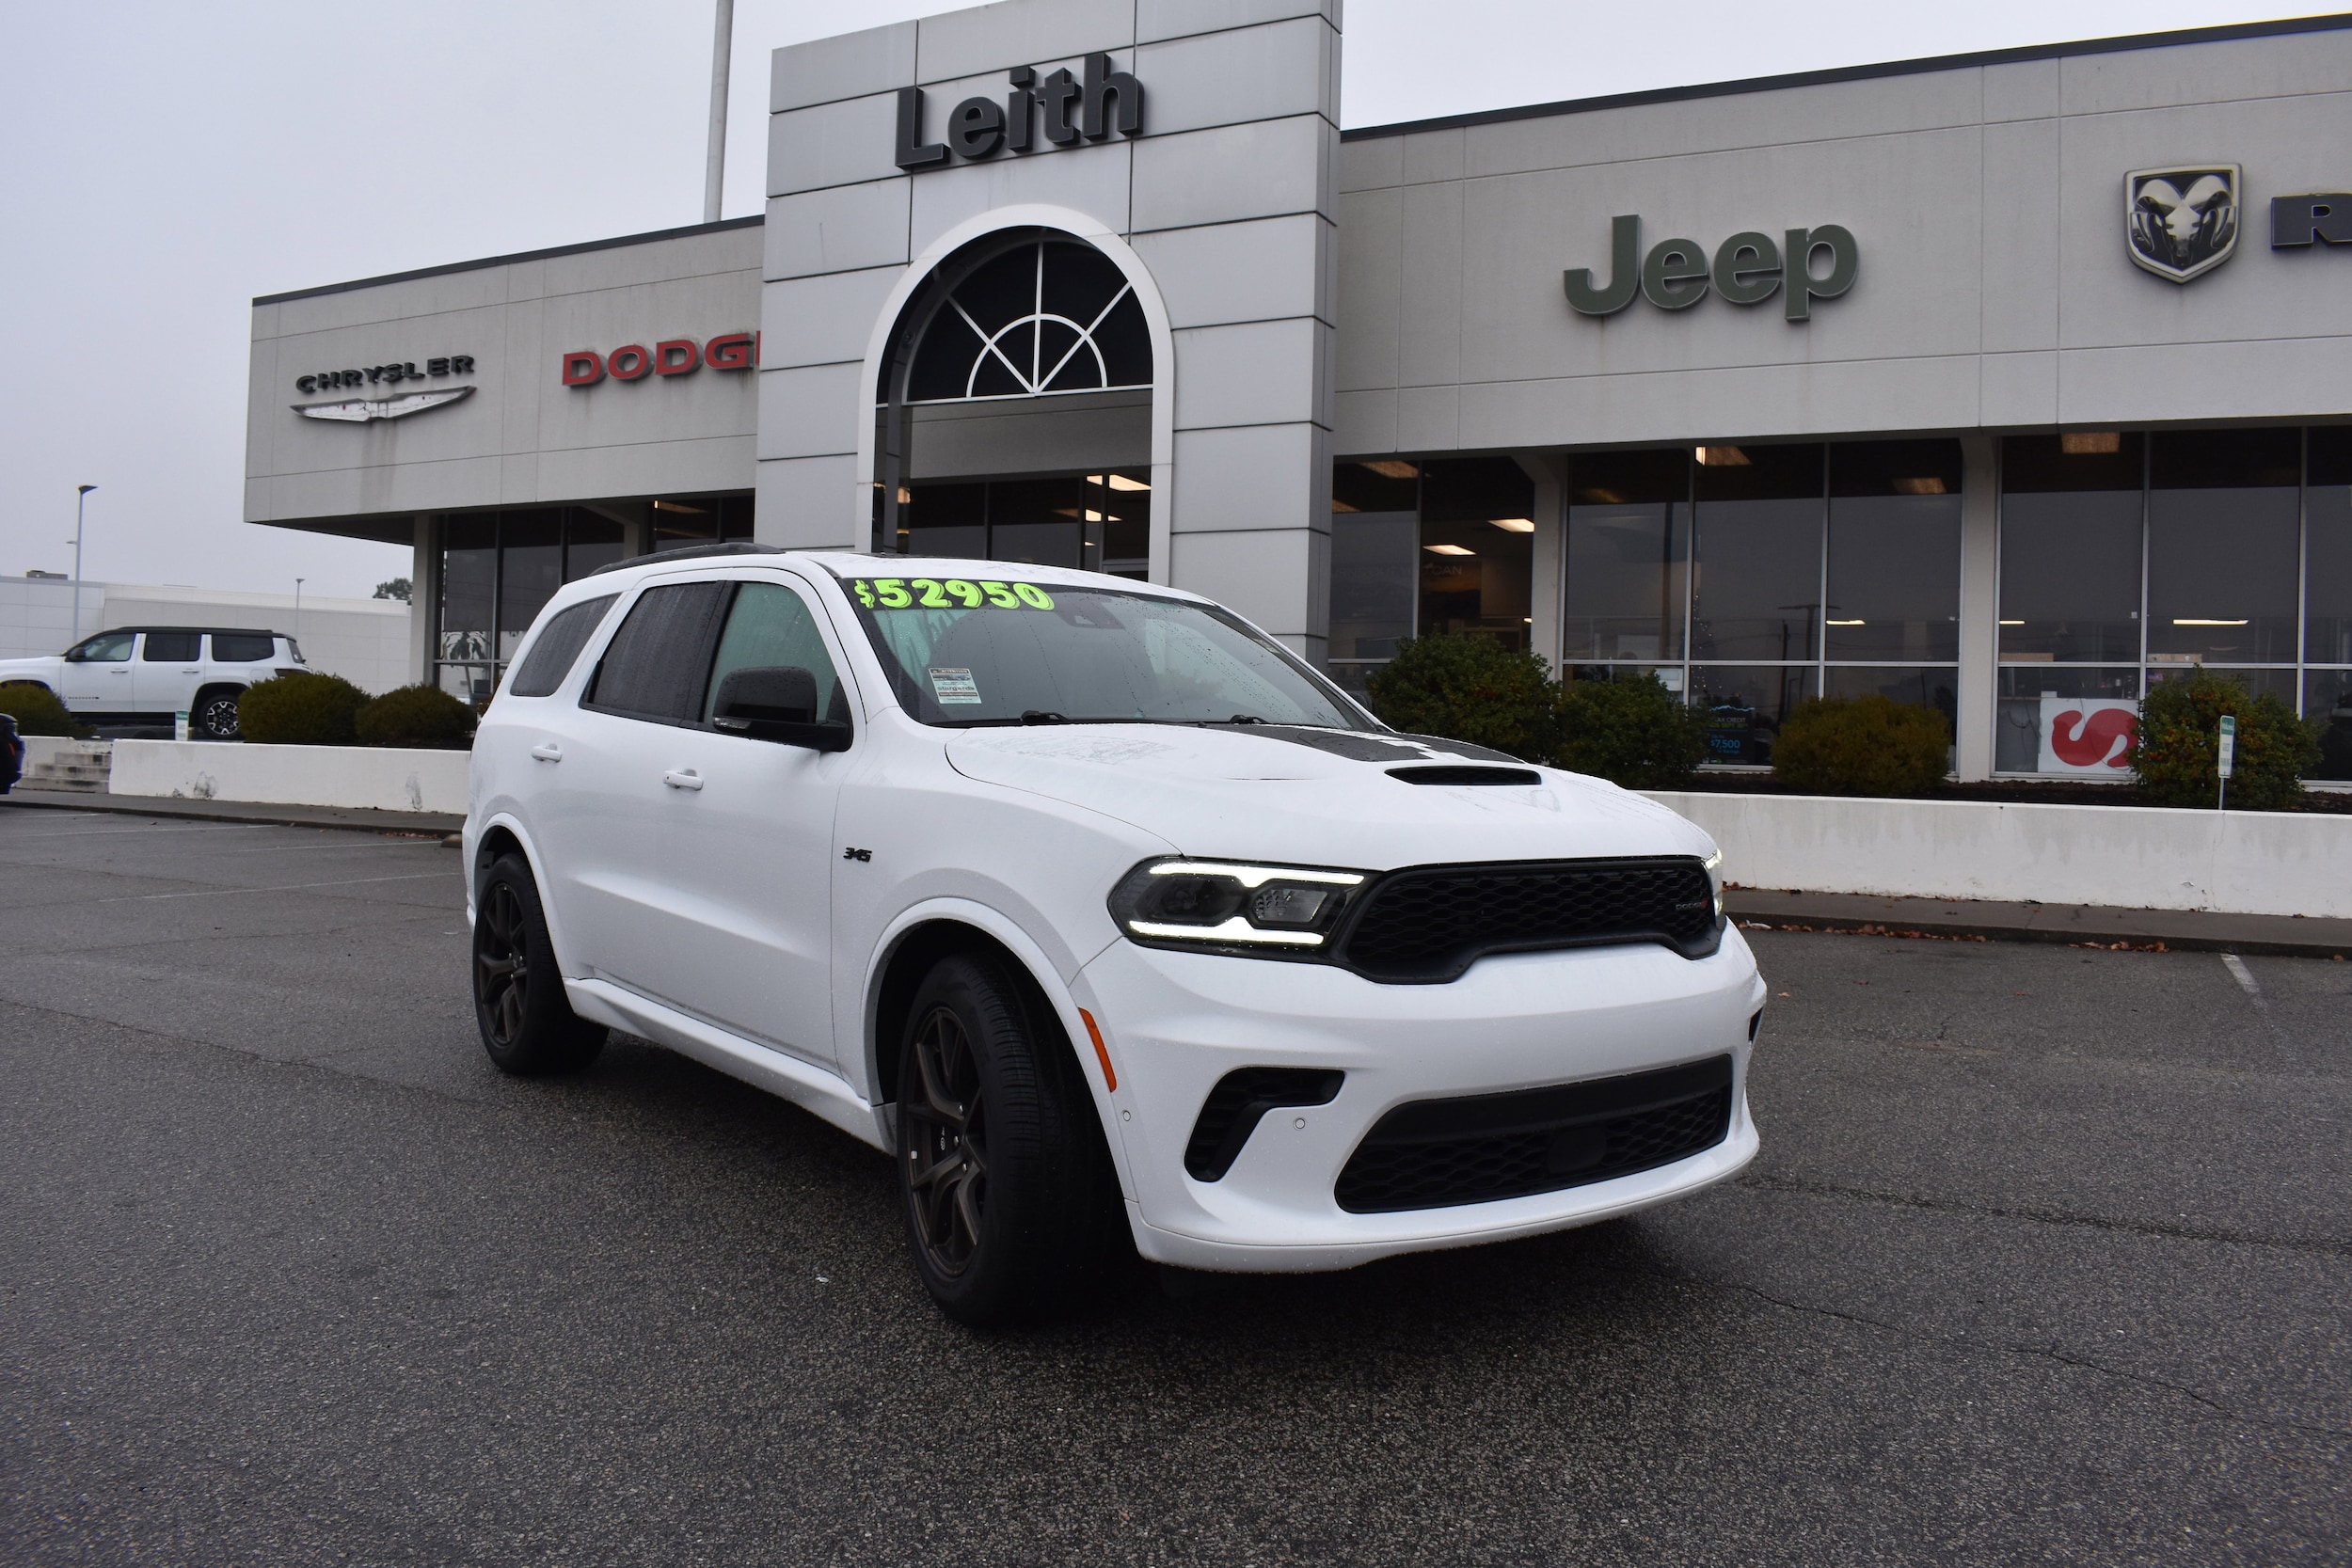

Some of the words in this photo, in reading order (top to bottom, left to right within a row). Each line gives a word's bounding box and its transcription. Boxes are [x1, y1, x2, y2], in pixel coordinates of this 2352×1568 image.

[896, 52, 1144, 171] Leith
[1564, 214, 1860, 321] Jeep
[295, 356, 474, 393] CHRYSLER
[562, 330, 761, 388] DODG
[853, 578, 1056, 610] $52950
[1710, 739, 1740, 750] $7,500
[843, 847, 872, 863] 345
